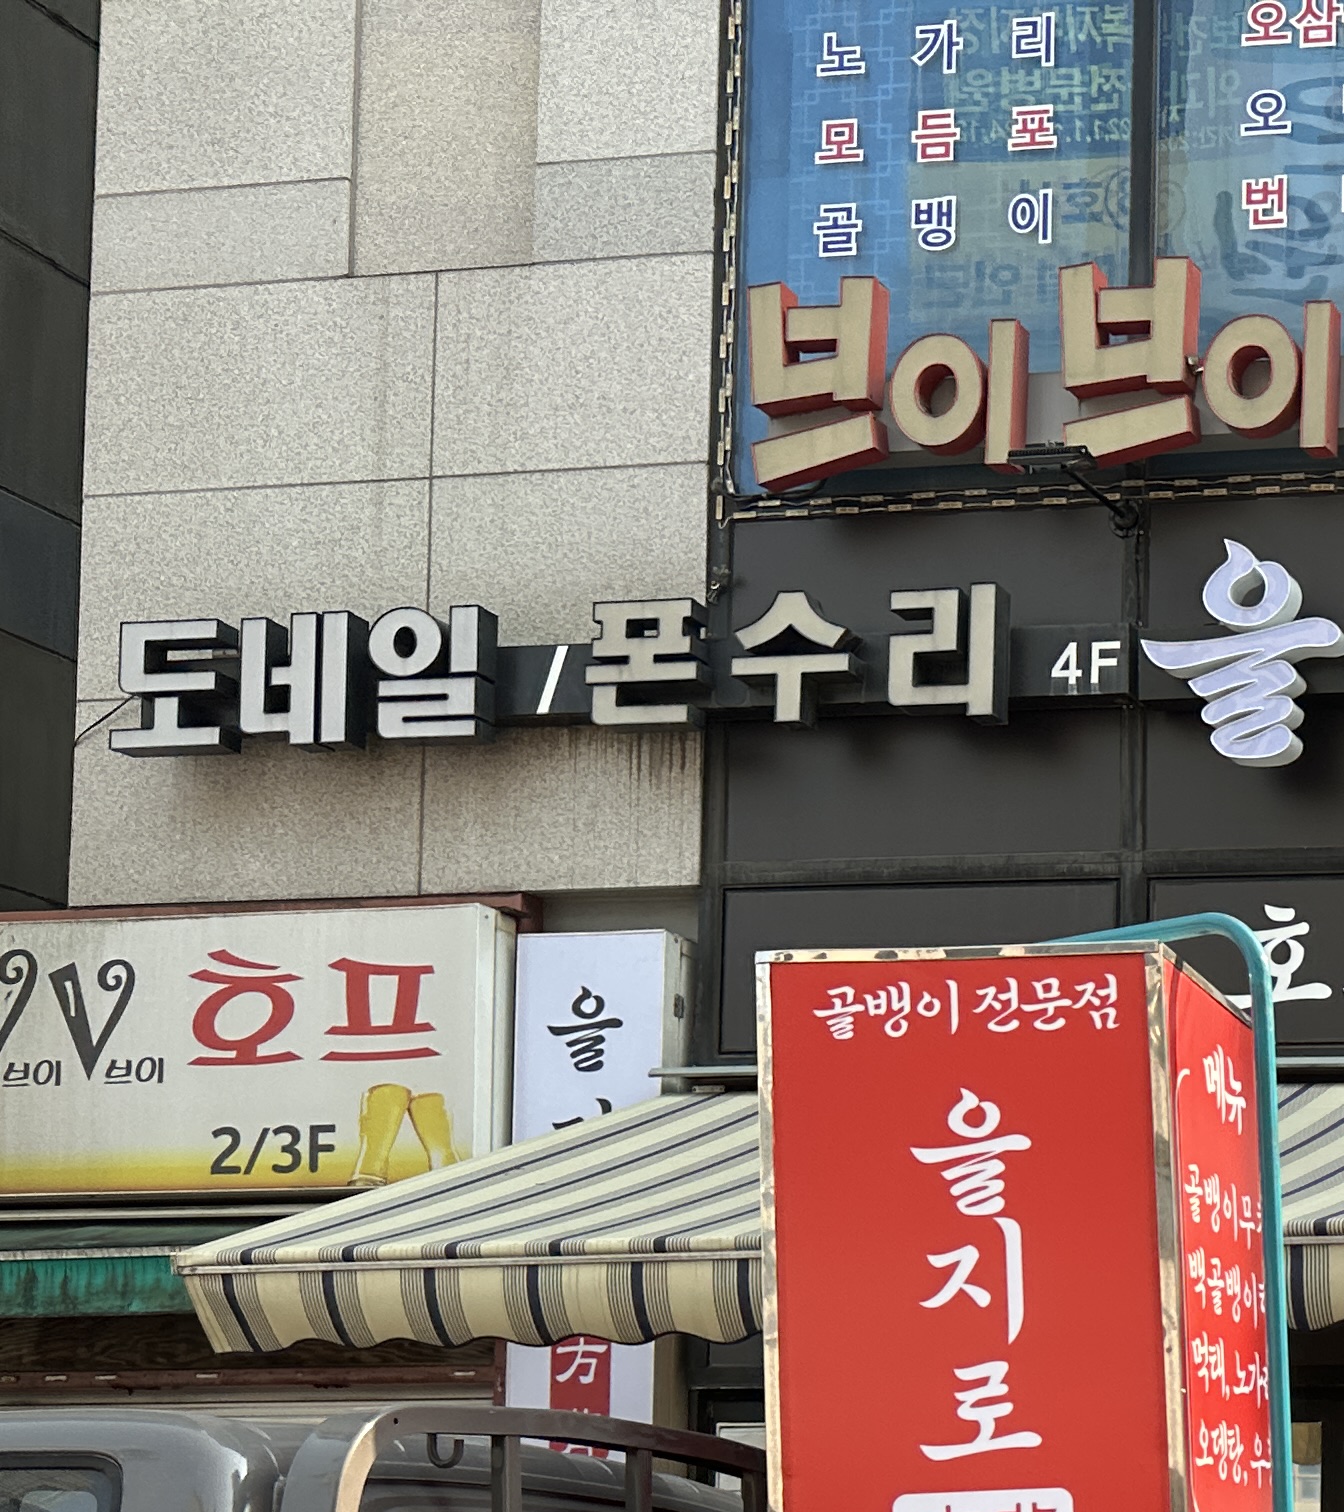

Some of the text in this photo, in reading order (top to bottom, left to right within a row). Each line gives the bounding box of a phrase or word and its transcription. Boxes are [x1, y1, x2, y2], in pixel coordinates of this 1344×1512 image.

[815, 11, 1058, 78] 노가리
[813, 104, 1059, 168] 모듬포
[812, 188, 1054, 259] 골뱅이
[109, 603, 498, 758] 도네일
[583, 582, 1012, 734] 폰수리
[1049, 640, 1121, 686] 4F
[187, 948, 442, 1066] 호프
[812, 972, 1122, 1041] 골뱅이 전문점
[103, 1056, 165, 1085] 브이
[1202, 1043, 1248, 1136] 메뉴
[209, 1123, 337, 1176] 2/3F
[1184, 1163, 1263, 1251] 골뱅이무
[909, 1086, 1043, 1463] 을지로
[1250, 1432, 1273, 1489] 우
